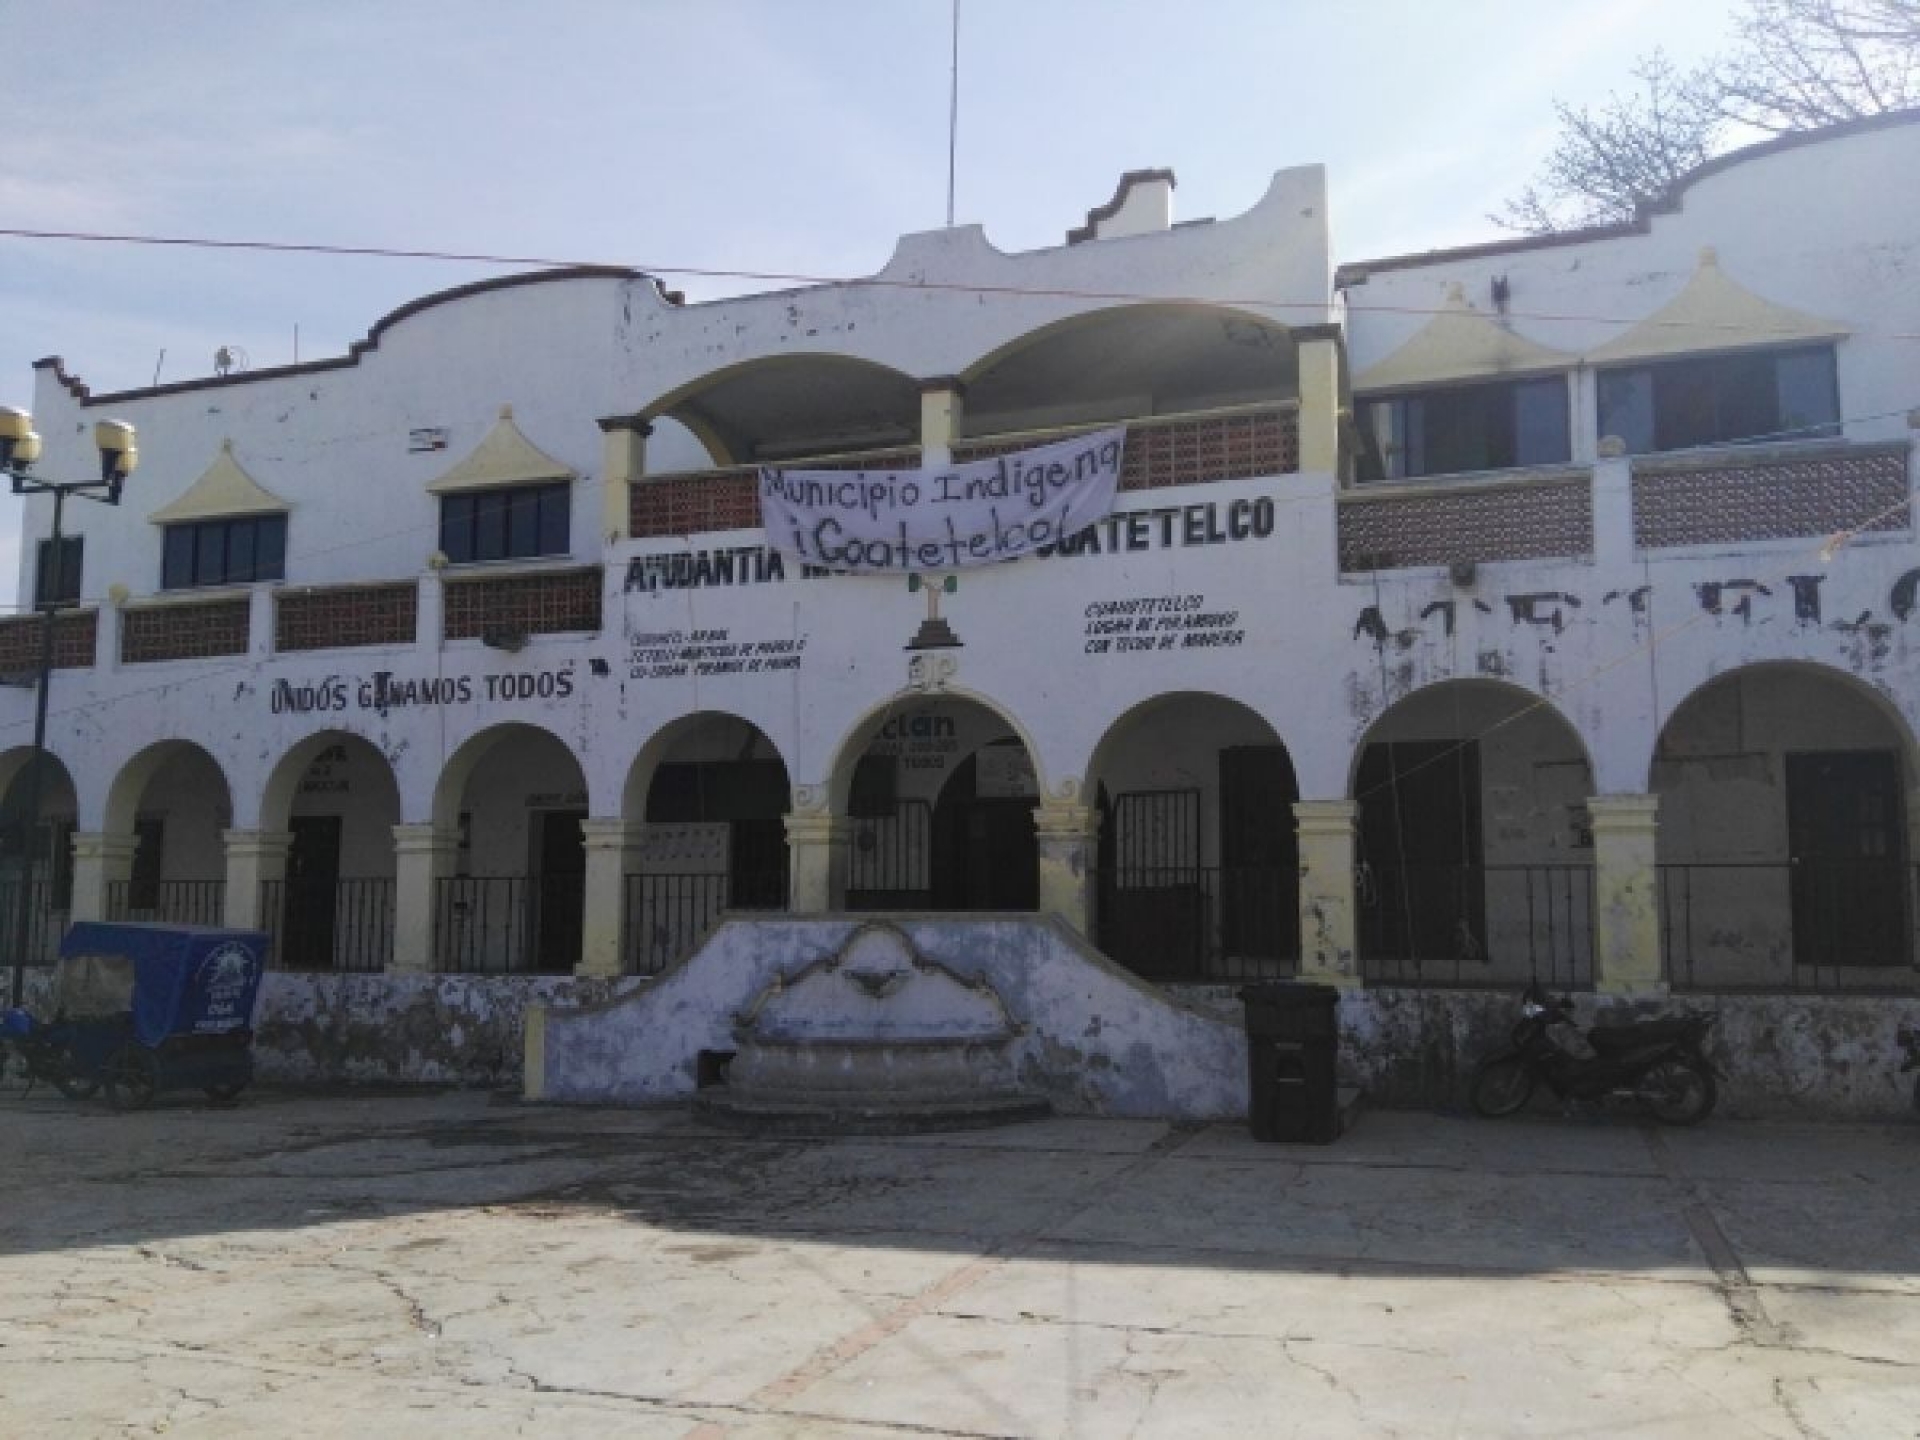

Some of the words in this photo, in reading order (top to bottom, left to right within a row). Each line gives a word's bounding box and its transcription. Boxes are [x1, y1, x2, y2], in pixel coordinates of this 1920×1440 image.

[761, 466, 919, 521] Municipio
[270, 677, 347, 715] UNIDOS
[484, 670, 574, 702] TODOS
